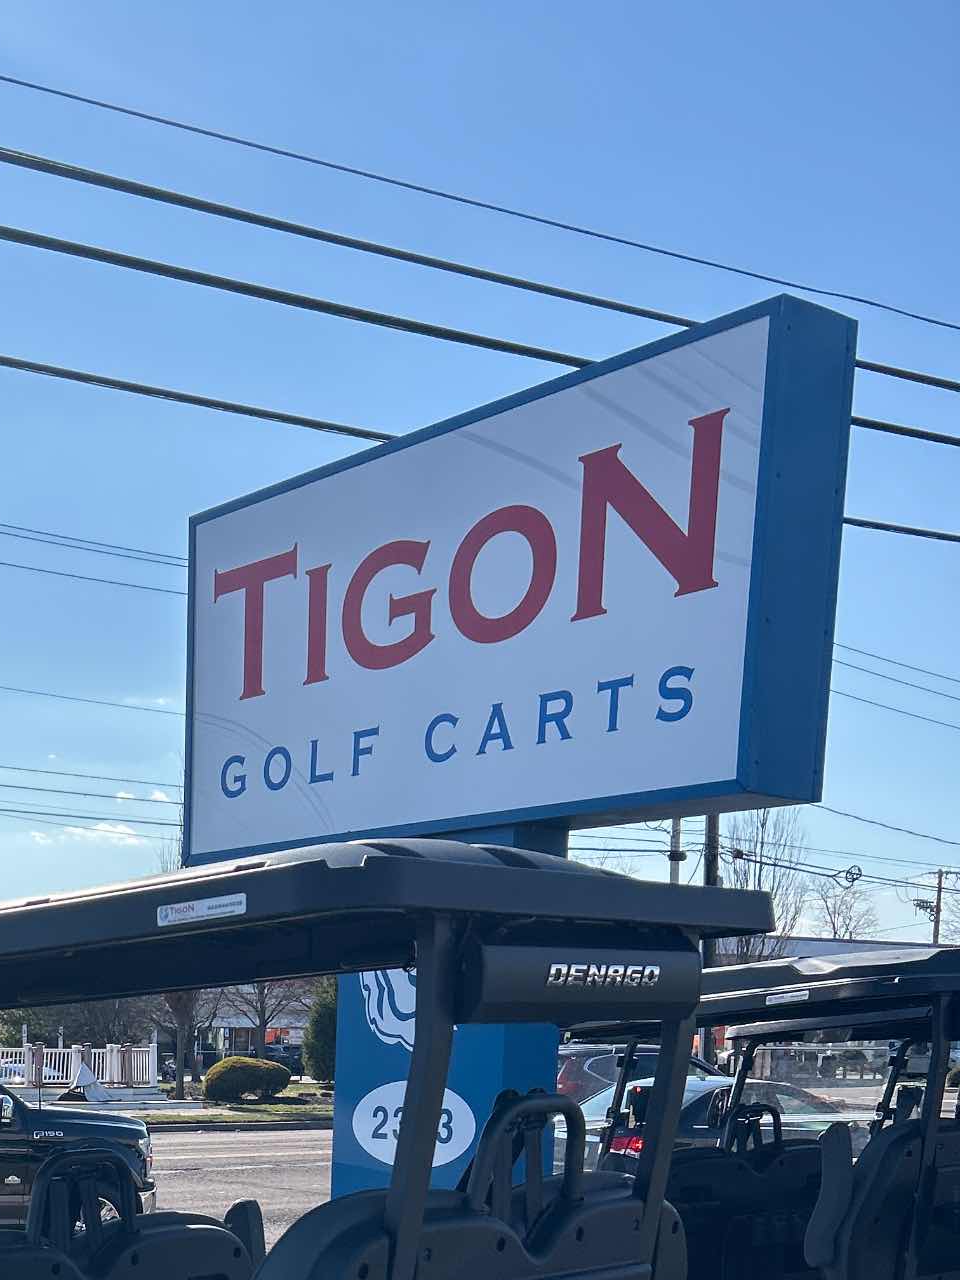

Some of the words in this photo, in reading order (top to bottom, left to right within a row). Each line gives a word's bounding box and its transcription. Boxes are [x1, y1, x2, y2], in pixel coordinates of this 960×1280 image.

[214, 407, 732, 701] TIGON
[220, 725, 381, 800] GOLF
[424, 665, 696, 764] CARTS
[546, 963, 660, 986] DENAGO
[371, 1105, 453, 1145] 23
